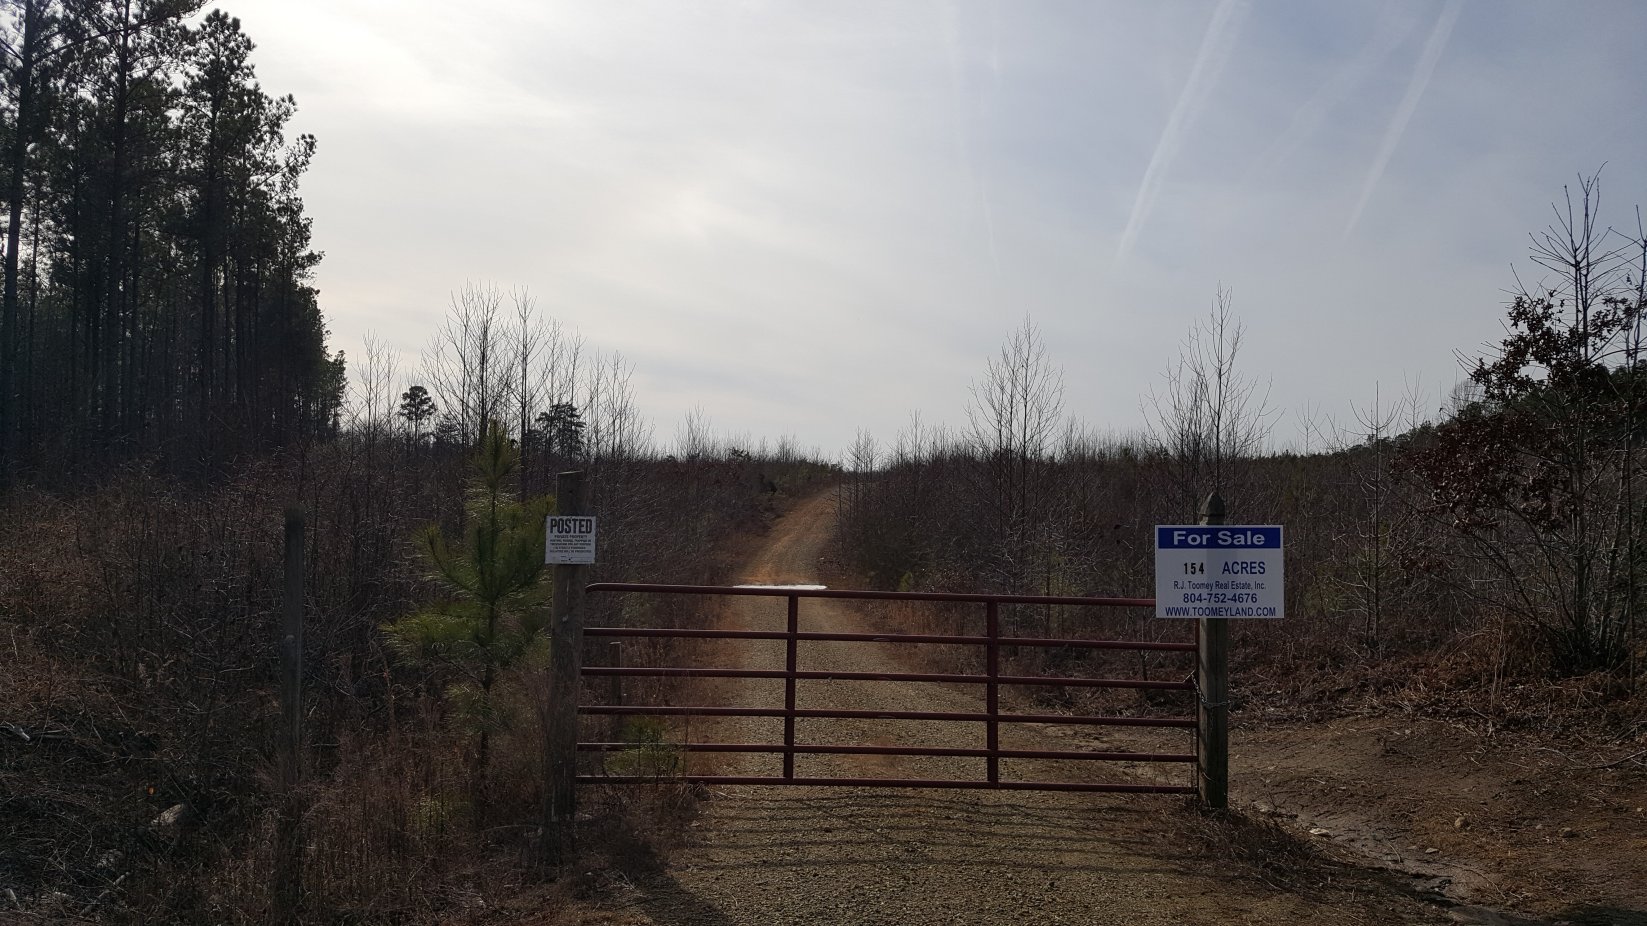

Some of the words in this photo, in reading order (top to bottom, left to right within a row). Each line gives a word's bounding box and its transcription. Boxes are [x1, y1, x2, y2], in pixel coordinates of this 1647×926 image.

[550, 518, 592, 534] POSTED
[1173, 531, 1211, 545] For
[1217, 531, 1265, 545] Sale
[1184, 562, 1204, 575] 154
[1222, 561, 1266, 575] ACRES
[1173, 581, 1186, 590] R.J.
[1188, 581, 1213, 592] Toomey
[1215, 581, 1230, 590] Real
[1254, 581, 1266, 590] Inc.
[1183, 593, 1258, 603] 804-752-4676
[1165, 607, 1276, 617] WWW.TOOMEYLAND.COM
